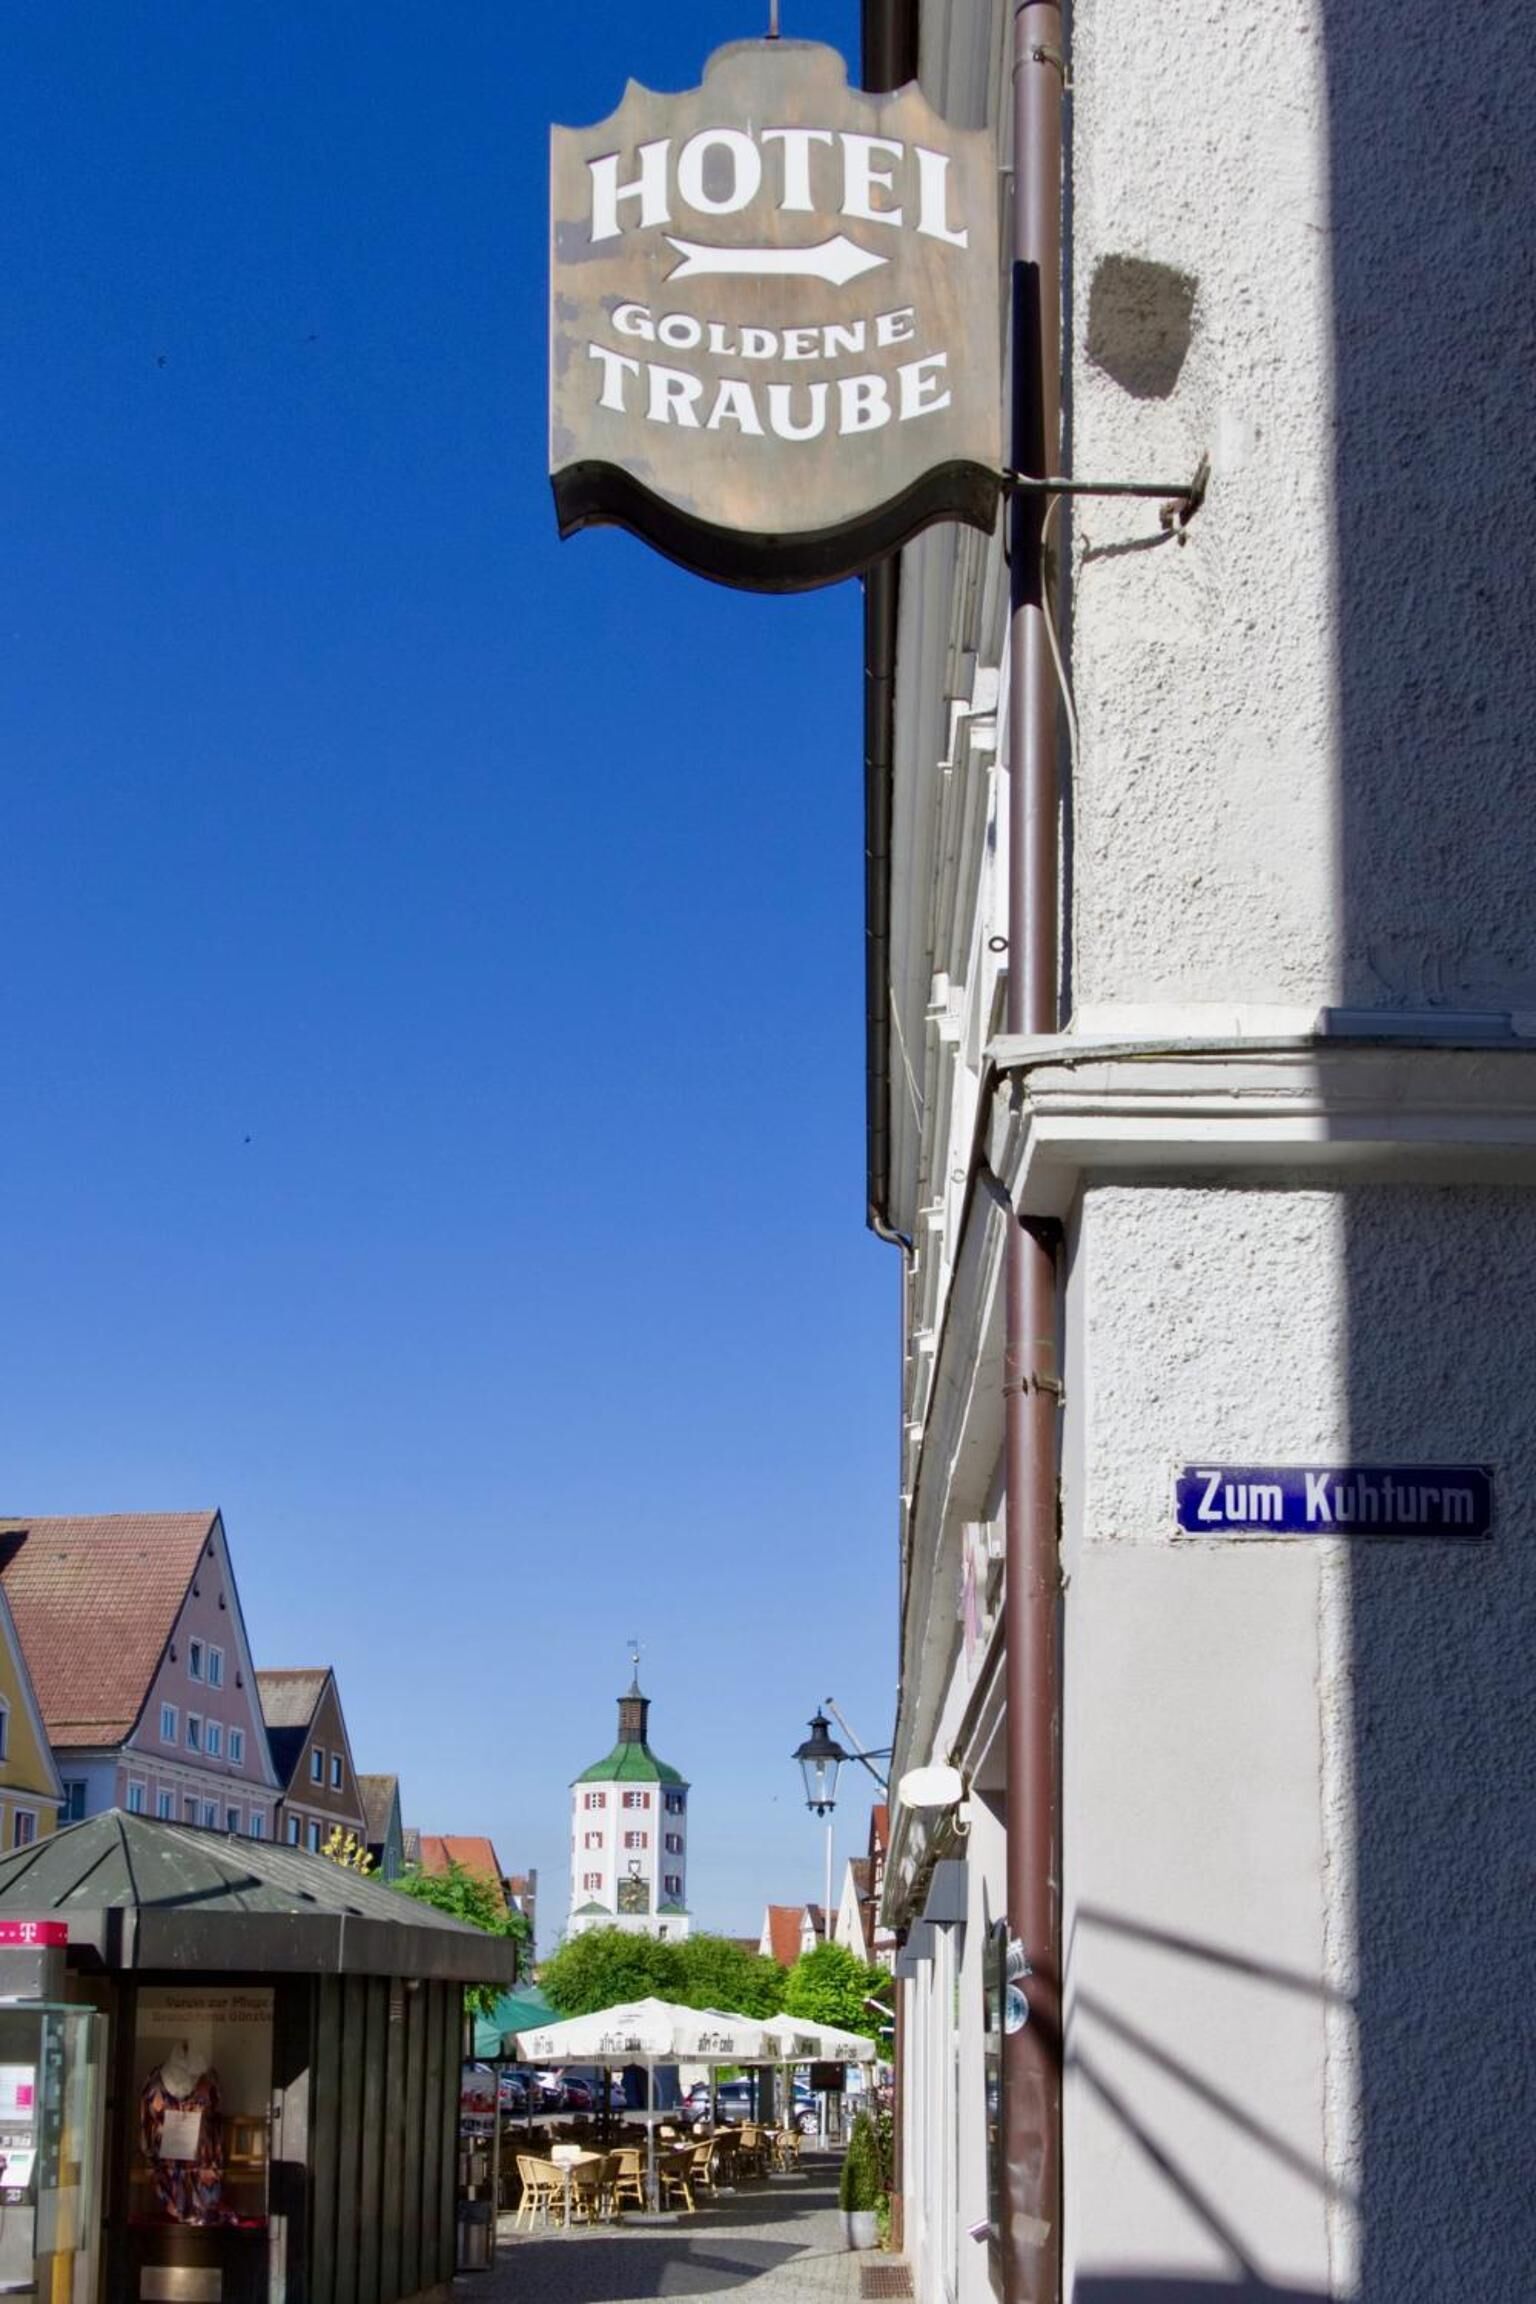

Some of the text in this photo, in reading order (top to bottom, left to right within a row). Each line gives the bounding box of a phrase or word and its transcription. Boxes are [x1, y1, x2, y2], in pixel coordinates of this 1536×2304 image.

[587, 128, 968, 249] HOTEL
[611, 303, 916, 361] GOLDENE
[589, 344, 951, 441] TRAUBE
[1196, 1471, 1475, 1523] Zum Kuhturm
